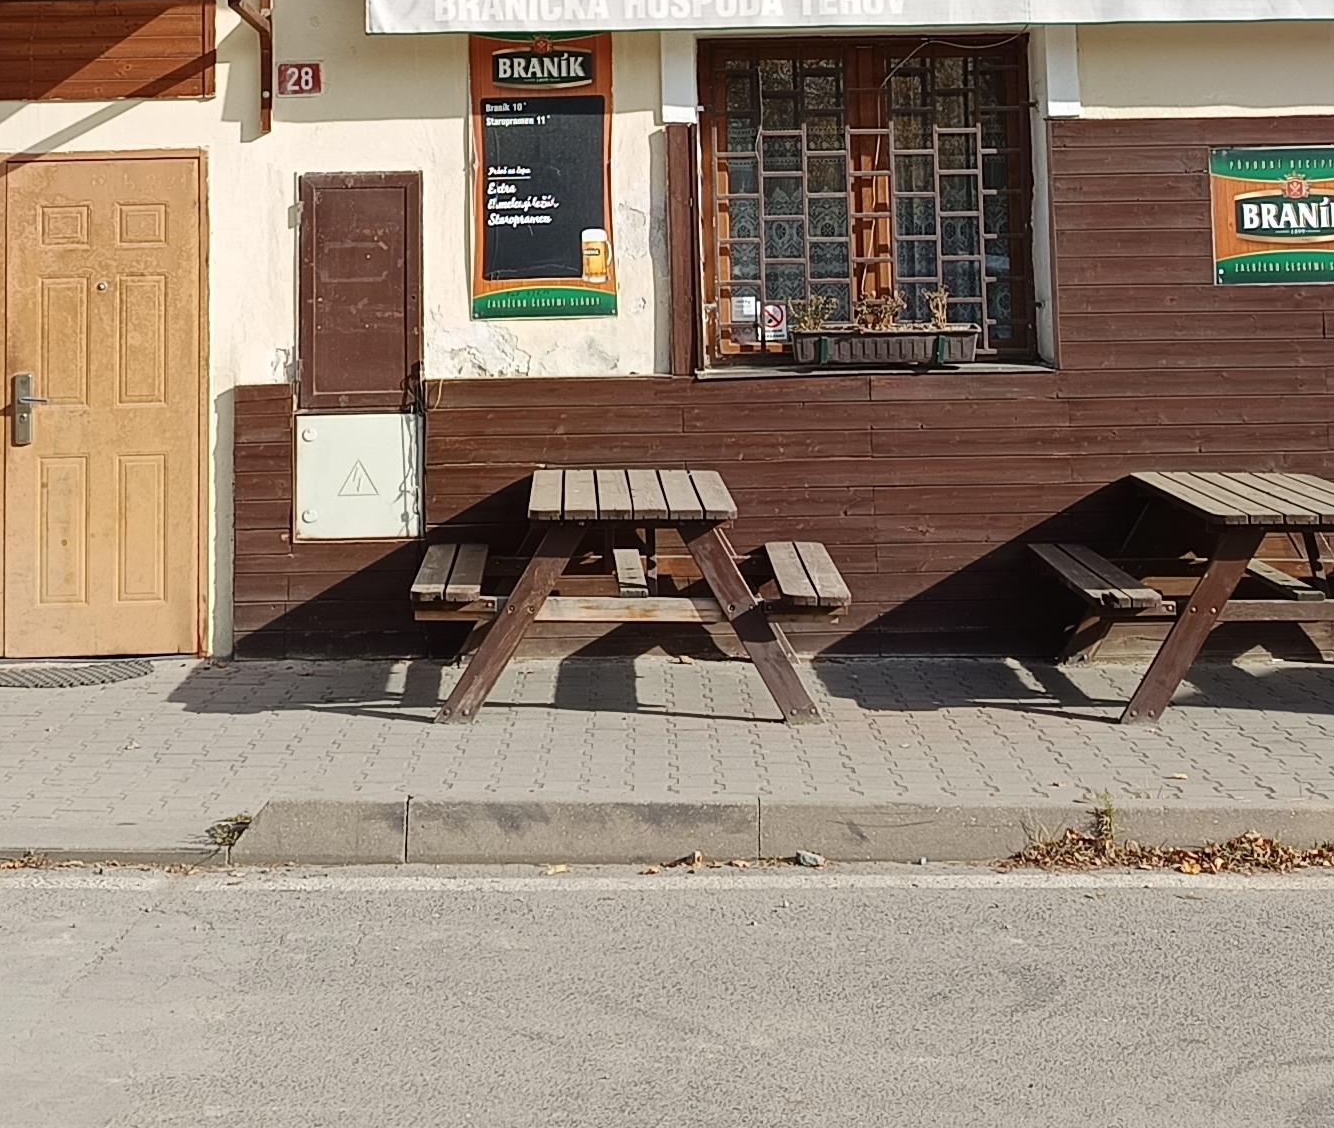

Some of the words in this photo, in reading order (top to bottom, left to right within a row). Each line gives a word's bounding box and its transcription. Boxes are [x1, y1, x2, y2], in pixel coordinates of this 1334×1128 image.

[497, 53, 586, 78] BRANÍK
[286, 66, 313, 91] 28
[485, 103, 510, 112] Braník
[485, 117, 535, 127] Staropramen
[487, 181, 517, 194] Extra
[487, 212, 553, 228] Staropramen
